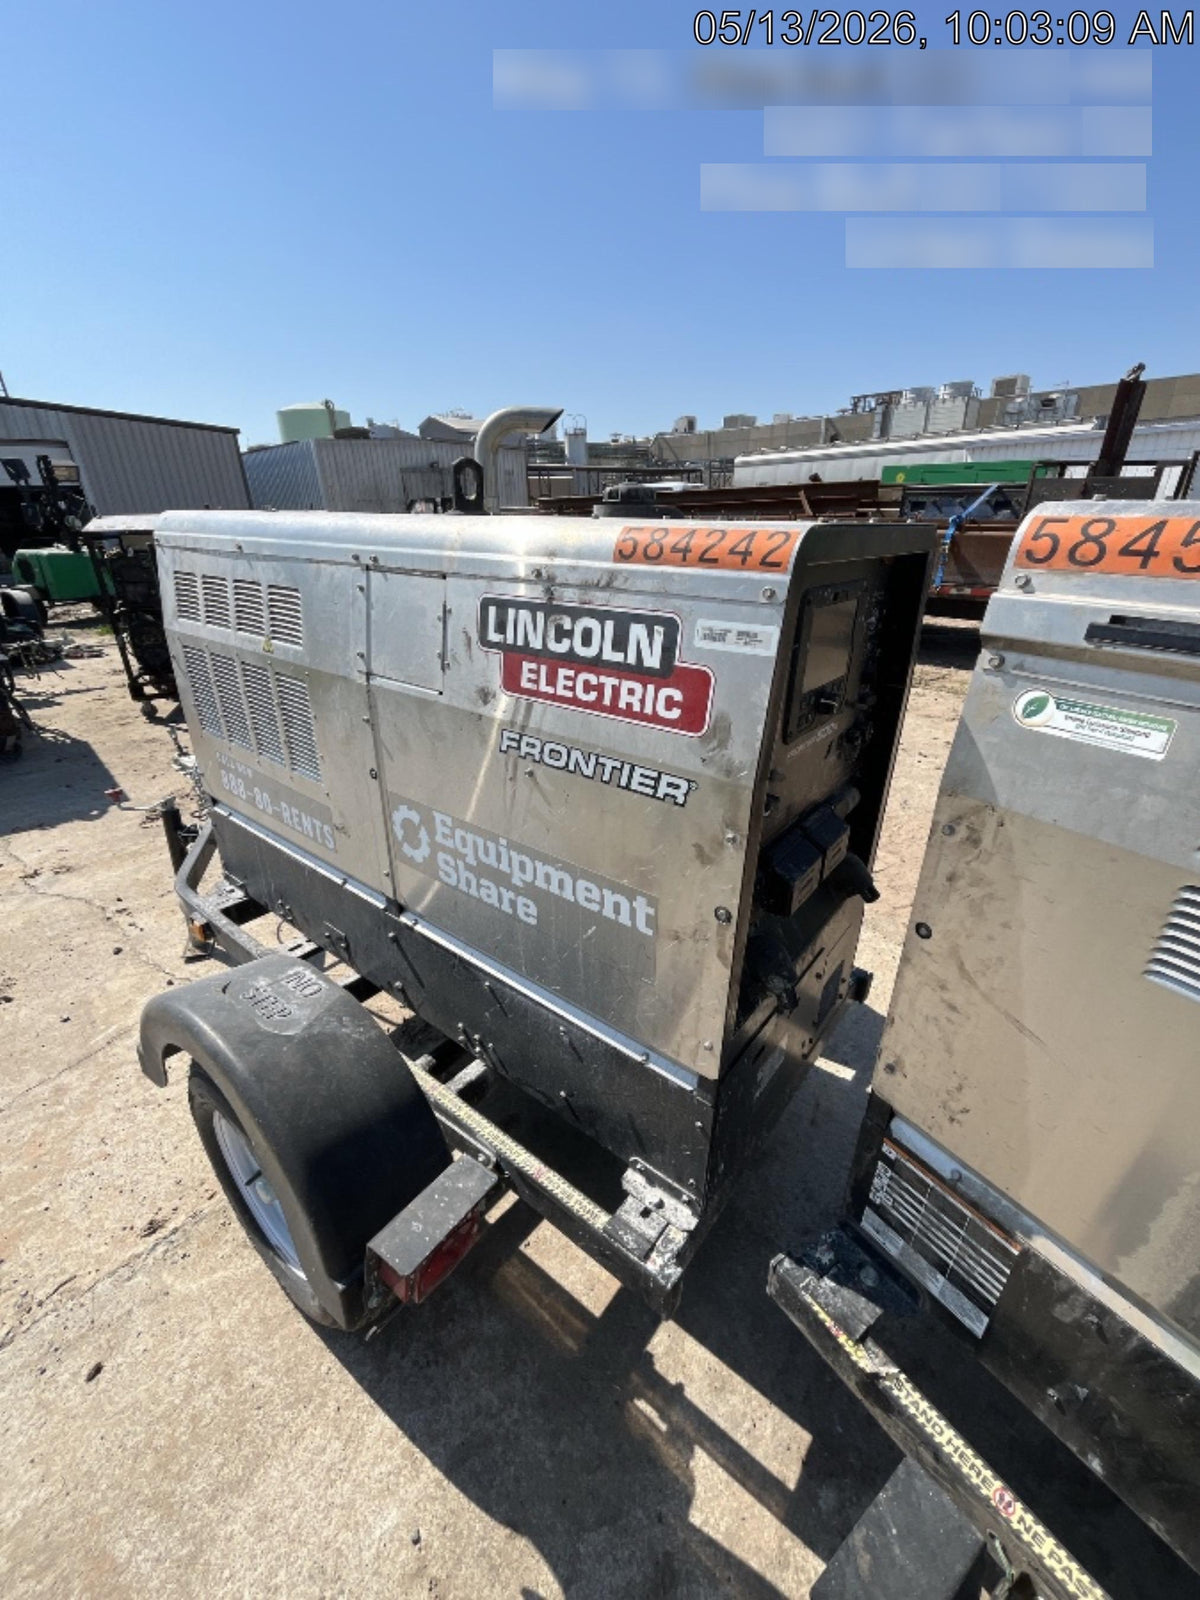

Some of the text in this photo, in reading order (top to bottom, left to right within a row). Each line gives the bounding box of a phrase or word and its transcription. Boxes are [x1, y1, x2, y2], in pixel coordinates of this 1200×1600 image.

[618, 527, 792, 568] 584242
[486, 604, 665, 670] LINCOLN
[519, 660, 684, 720] ELECTRIC
[219, 768, 336, 852] 888-80-RENTS
[431, 810, 656, 937] Equipment
[436, 850, 539, 927] Share
[240, 985, 293, 1020] STEP
[284, 969, 323, 999] NO
[893, 1376, 946, 1437] STAND
[946, 1438, 996, 1491] HERE
[1016, 1514, 1047, 1550] NE
